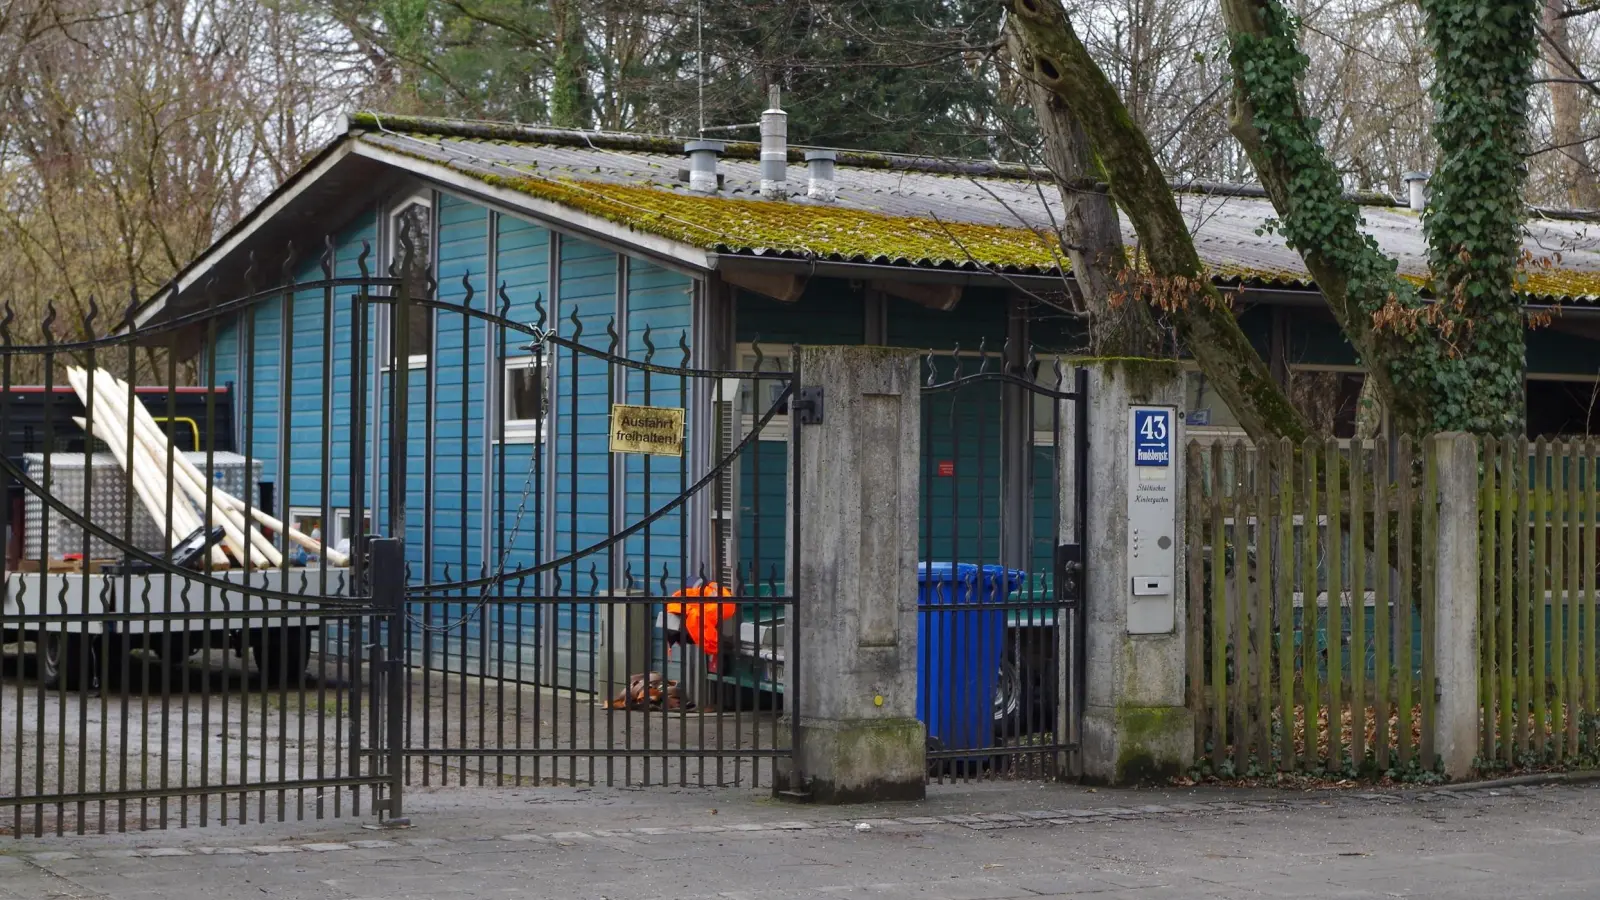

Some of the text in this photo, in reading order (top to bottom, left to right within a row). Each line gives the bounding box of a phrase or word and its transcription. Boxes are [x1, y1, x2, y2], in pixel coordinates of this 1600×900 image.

[621, 416, 673, 429] Ausfahrt
[1140, 415, 1166, 440] 43
[617, 430, 677, 444] freihalten!
